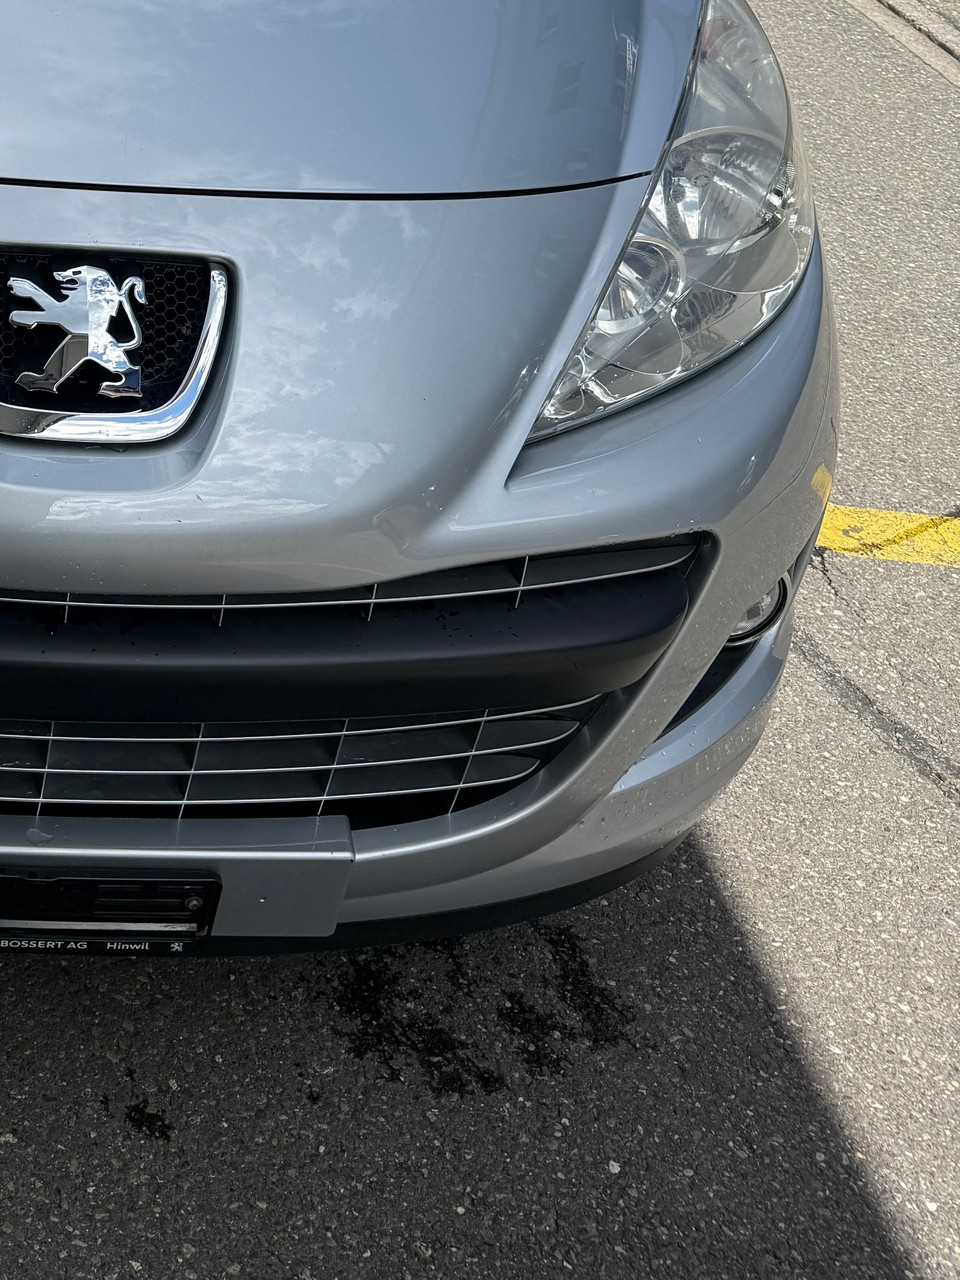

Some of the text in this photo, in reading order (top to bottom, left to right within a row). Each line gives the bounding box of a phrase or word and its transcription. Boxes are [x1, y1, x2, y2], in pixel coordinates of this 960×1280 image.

[0, 940, 65, 949] BOSSERT
[67, 941, 88, 950] AG
[106, 941, 150, 951] Hinwil
